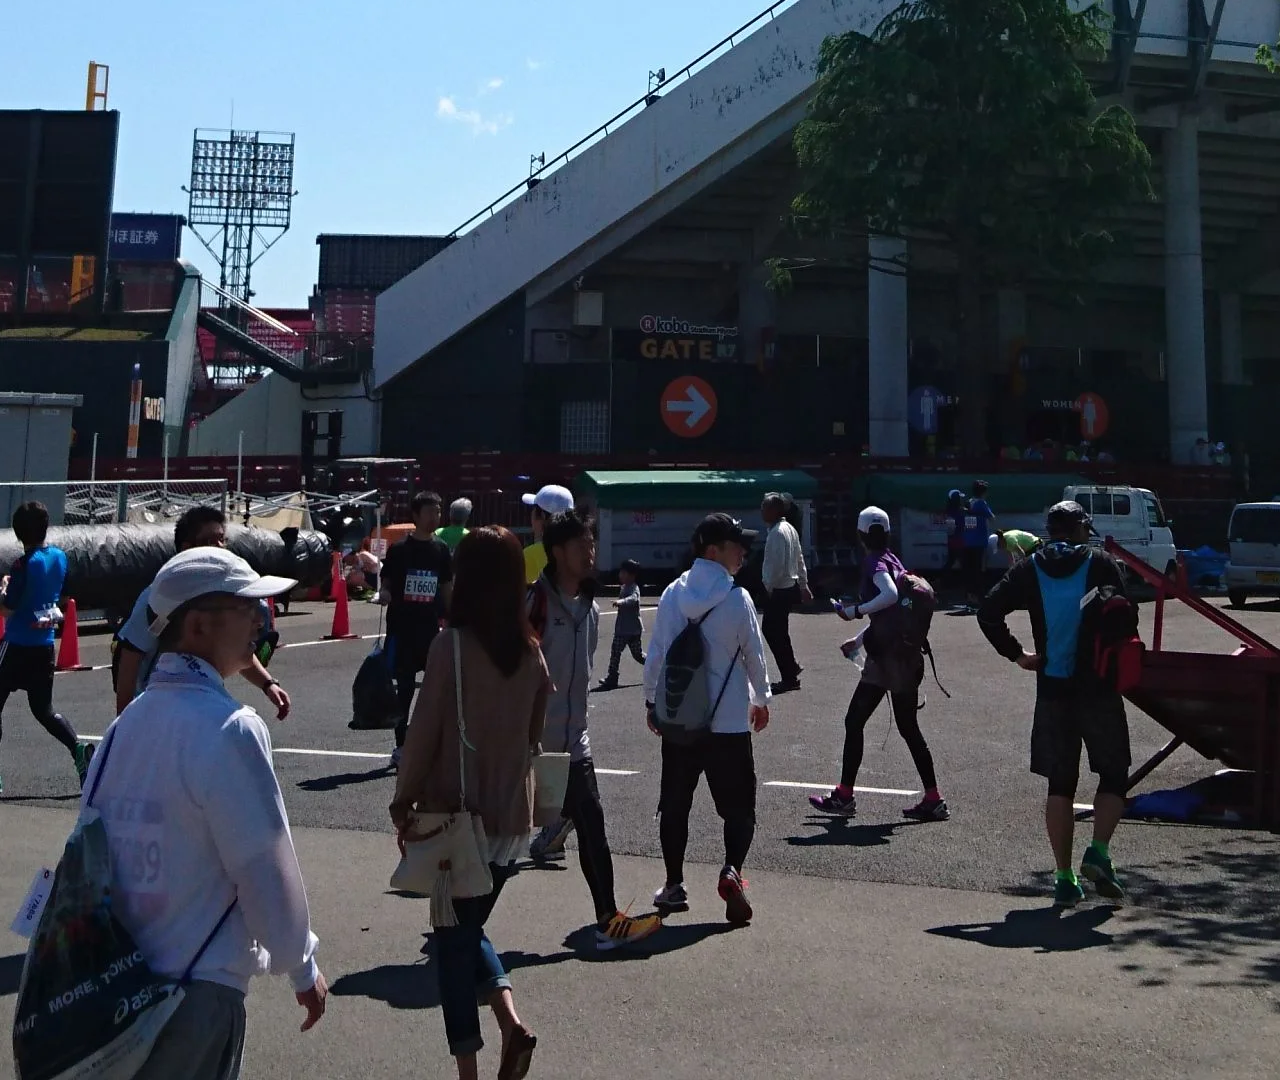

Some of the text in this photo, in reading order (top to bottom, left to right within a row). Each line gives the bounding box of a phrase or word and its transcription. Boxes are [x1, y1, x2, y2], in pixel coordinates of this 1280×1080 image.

[656, 316, 690, 332] kobo
[640, 338, 712, 360] GATE
[1042, 400, 1081, 409] WOMEN
[406, 580, 437, 594] E16600
[100, 951, 144, 985] TOKYO
